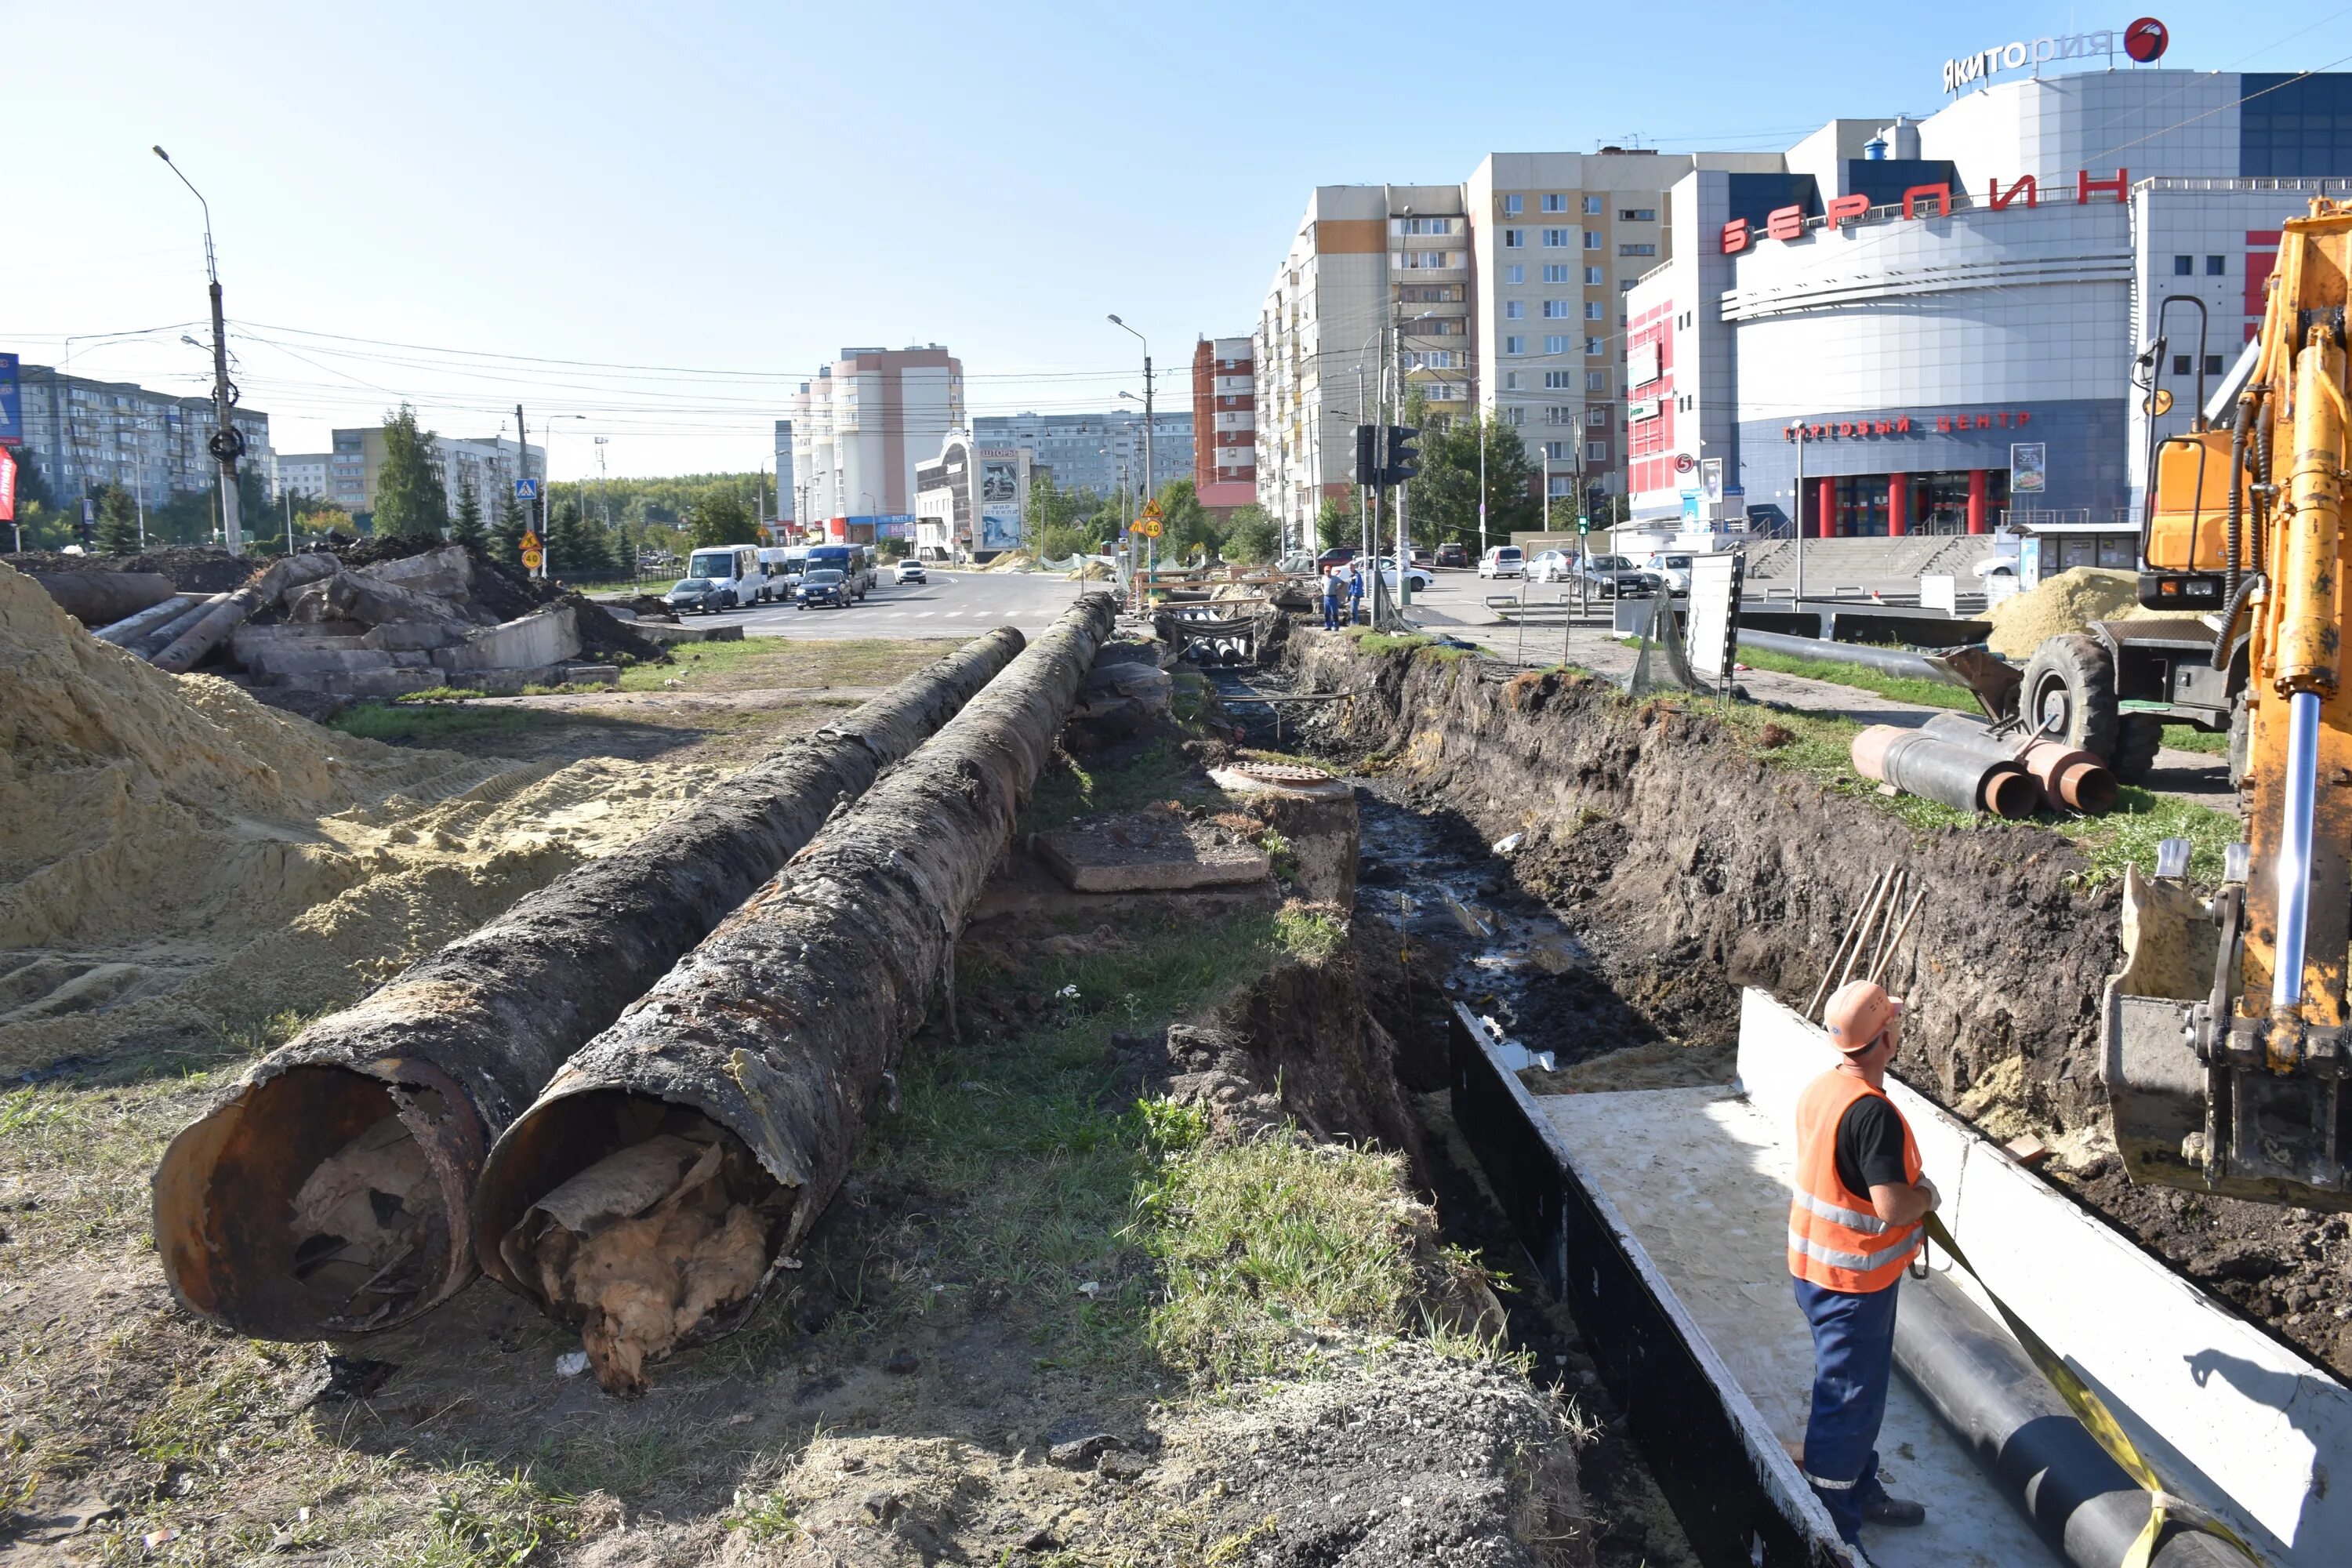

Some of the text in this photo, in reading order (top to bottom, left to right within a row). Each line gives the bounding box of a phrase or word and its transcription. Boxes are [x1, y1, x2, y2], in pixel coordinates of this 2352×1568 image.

[1721, 168, 2128, 254] БЕРЛИН
[1936, 411, 2031, 433] ЦЕНТР
[526, 554, 538, 563] 40
